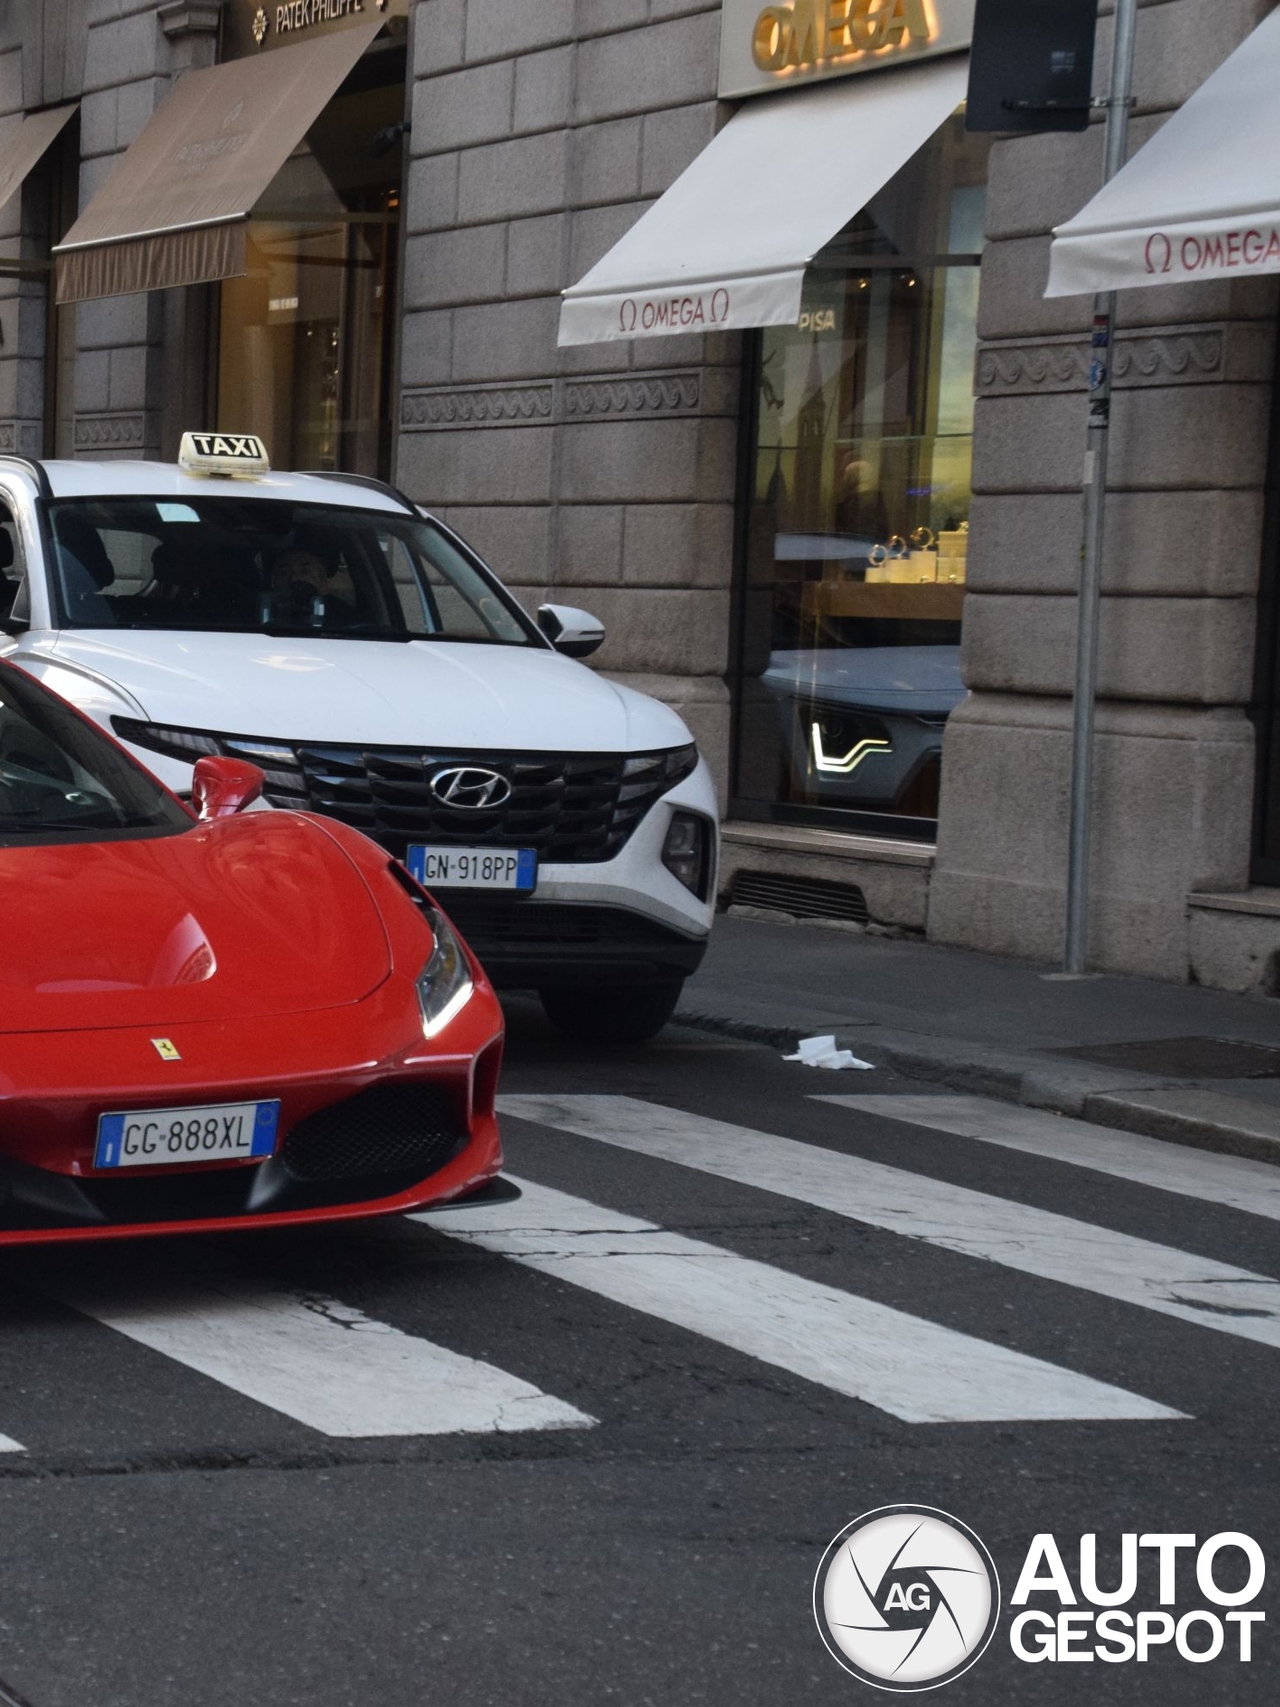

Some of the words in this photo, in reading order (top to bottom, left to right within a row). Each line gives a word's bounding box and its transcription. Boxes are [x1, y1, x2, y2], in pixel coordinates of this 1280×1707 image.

[275, 0, 309, 34] PATEK
[751, 0, 930, 71] OMEGA
[1181, 229, 1280, 271] OMEGA
[641, 297, 705, 329] OMEGA
[798, 309, 836, 332] PISA
[193, 435, 259, 457] TAXI
